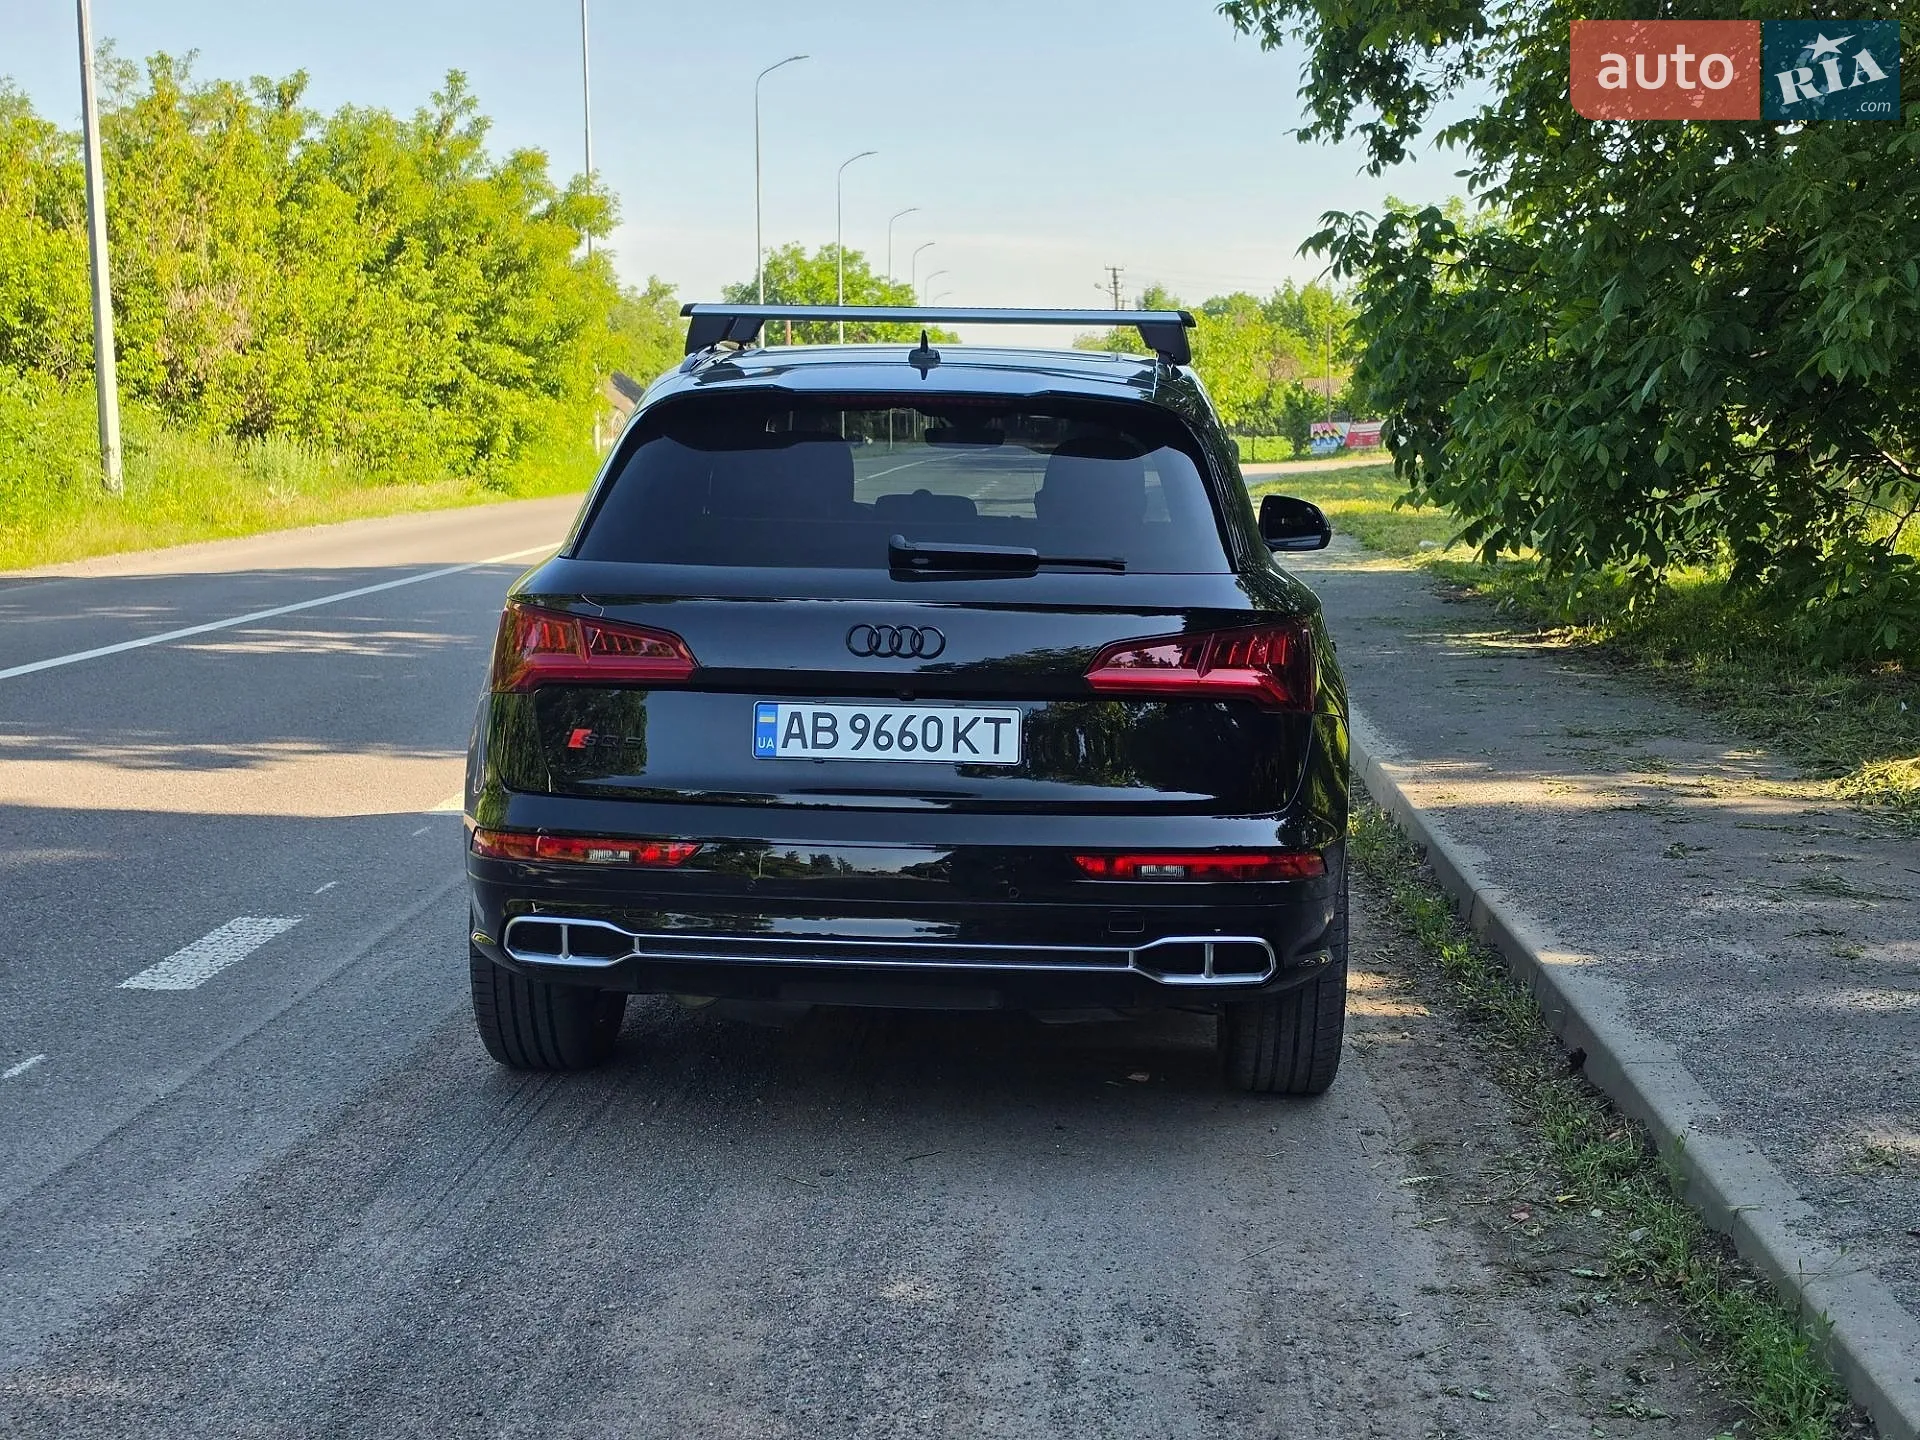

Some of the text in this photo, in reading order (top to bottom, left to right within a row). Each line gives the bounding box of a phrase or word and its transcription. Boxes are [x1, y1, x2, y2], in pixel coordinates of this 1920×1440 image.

[758, 737, 775, 749] UA
[781, 711, 1012, 755] AB 9660 KT
